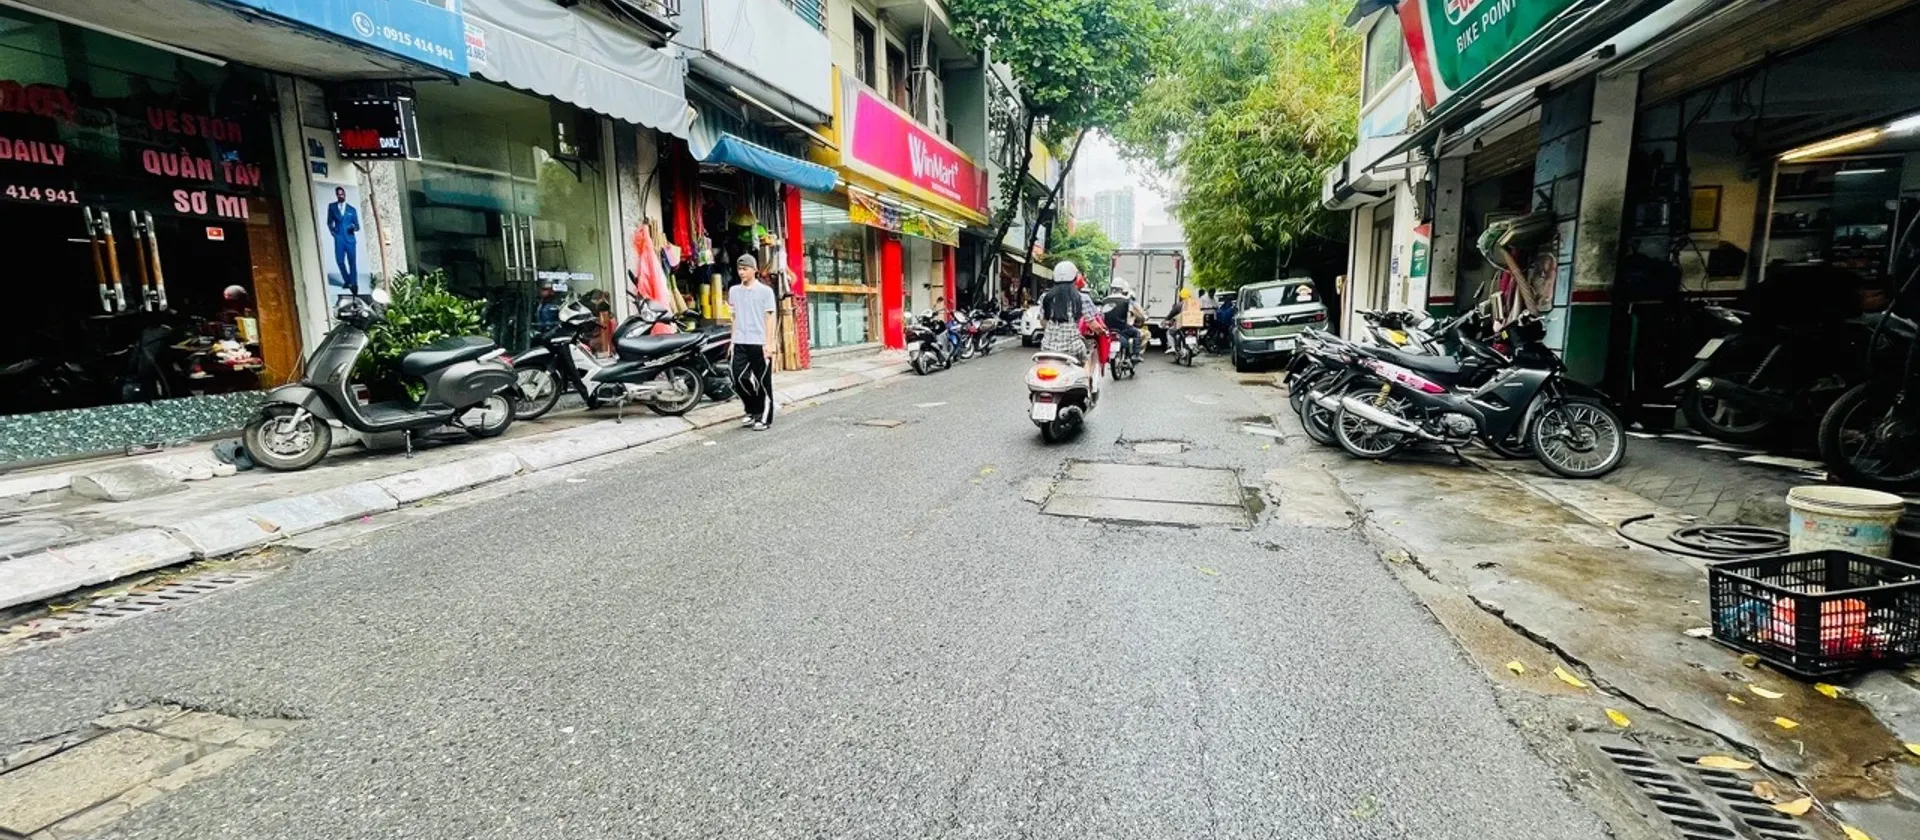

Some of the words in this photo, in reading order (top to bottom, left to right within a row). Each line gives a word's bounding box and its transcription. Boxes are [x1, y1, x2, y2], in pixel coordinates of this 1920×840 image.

[383, 26, 412, 46] 0915
[414, 38, 434, 54] 414
[435, 45, 455, 60] 941
[1456, 21, 1479, 54] BIKE
[0, 136, 65, 166] DAILY
[379, 136, 400, 149] DAILY
[142, 146, 215, 181] QUẦN
[5, 184, 41, 201] 414
[44, 188, 79, 204] 941
[172, 189, 208, 215] SƠ
[215, 194, 249, 219] MI
